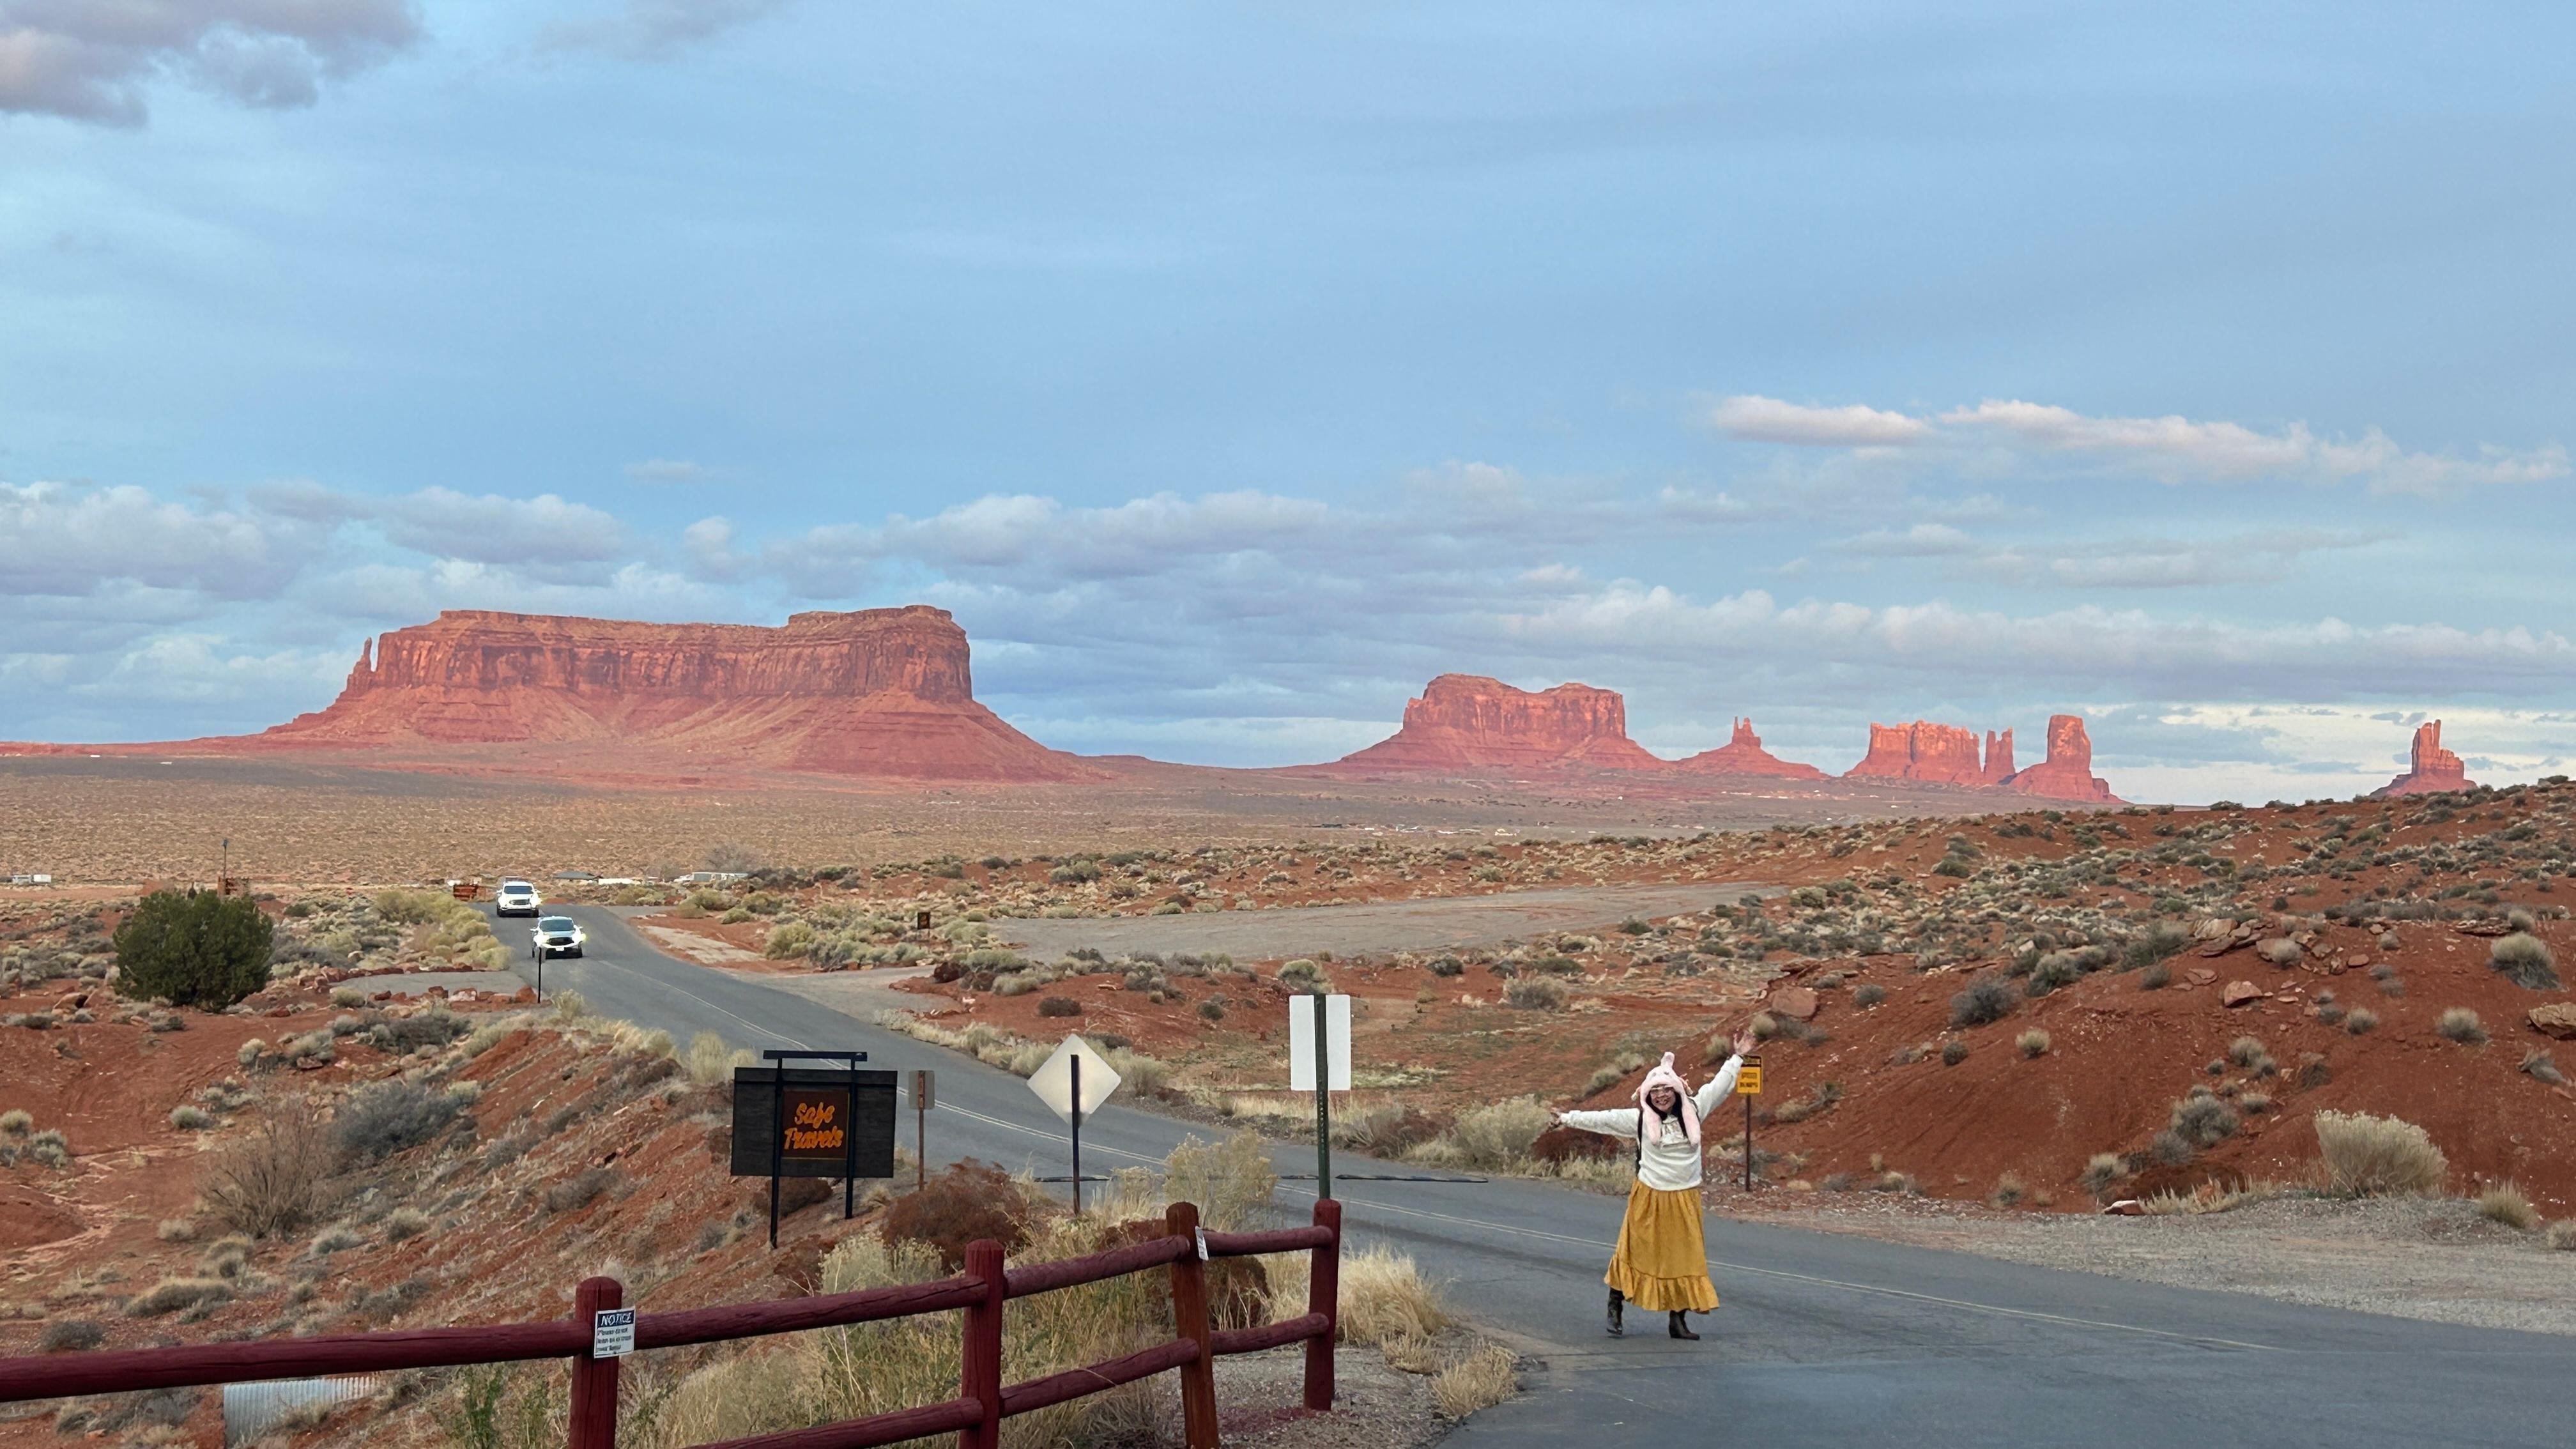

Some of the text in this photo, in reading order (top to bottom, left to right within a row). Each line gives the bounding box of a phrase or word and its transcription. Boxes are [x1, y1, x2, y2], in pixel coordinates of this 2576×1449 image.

[794, 1102, 835, 1128] Safe
[784, 1126, 843, 1149] Travels
[601, 1312, 631, 1326] NOTICE
